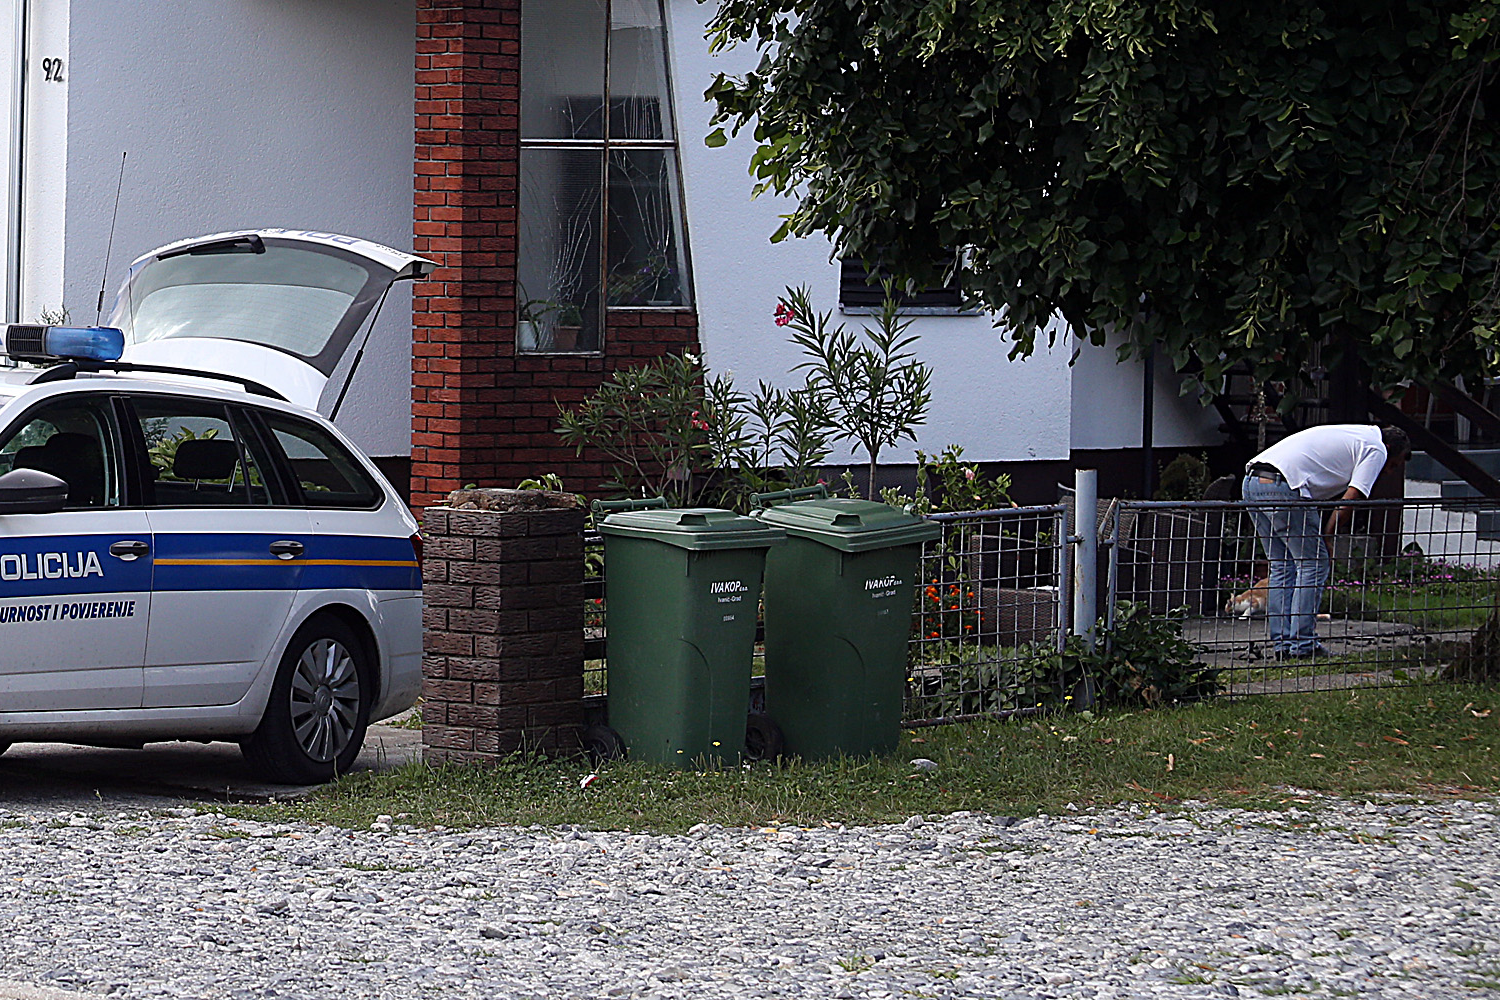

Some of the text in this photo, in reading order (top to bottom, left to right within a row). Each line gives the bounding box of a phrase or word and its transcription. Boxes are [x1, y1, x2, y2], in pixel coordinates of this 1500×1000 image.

[42, 57, 64, 83] 92
[710, 580, 741, 594] IVAKOP
[52, 604, 59, 621] I
[60, 601, 136, 620] POVJERENJE
